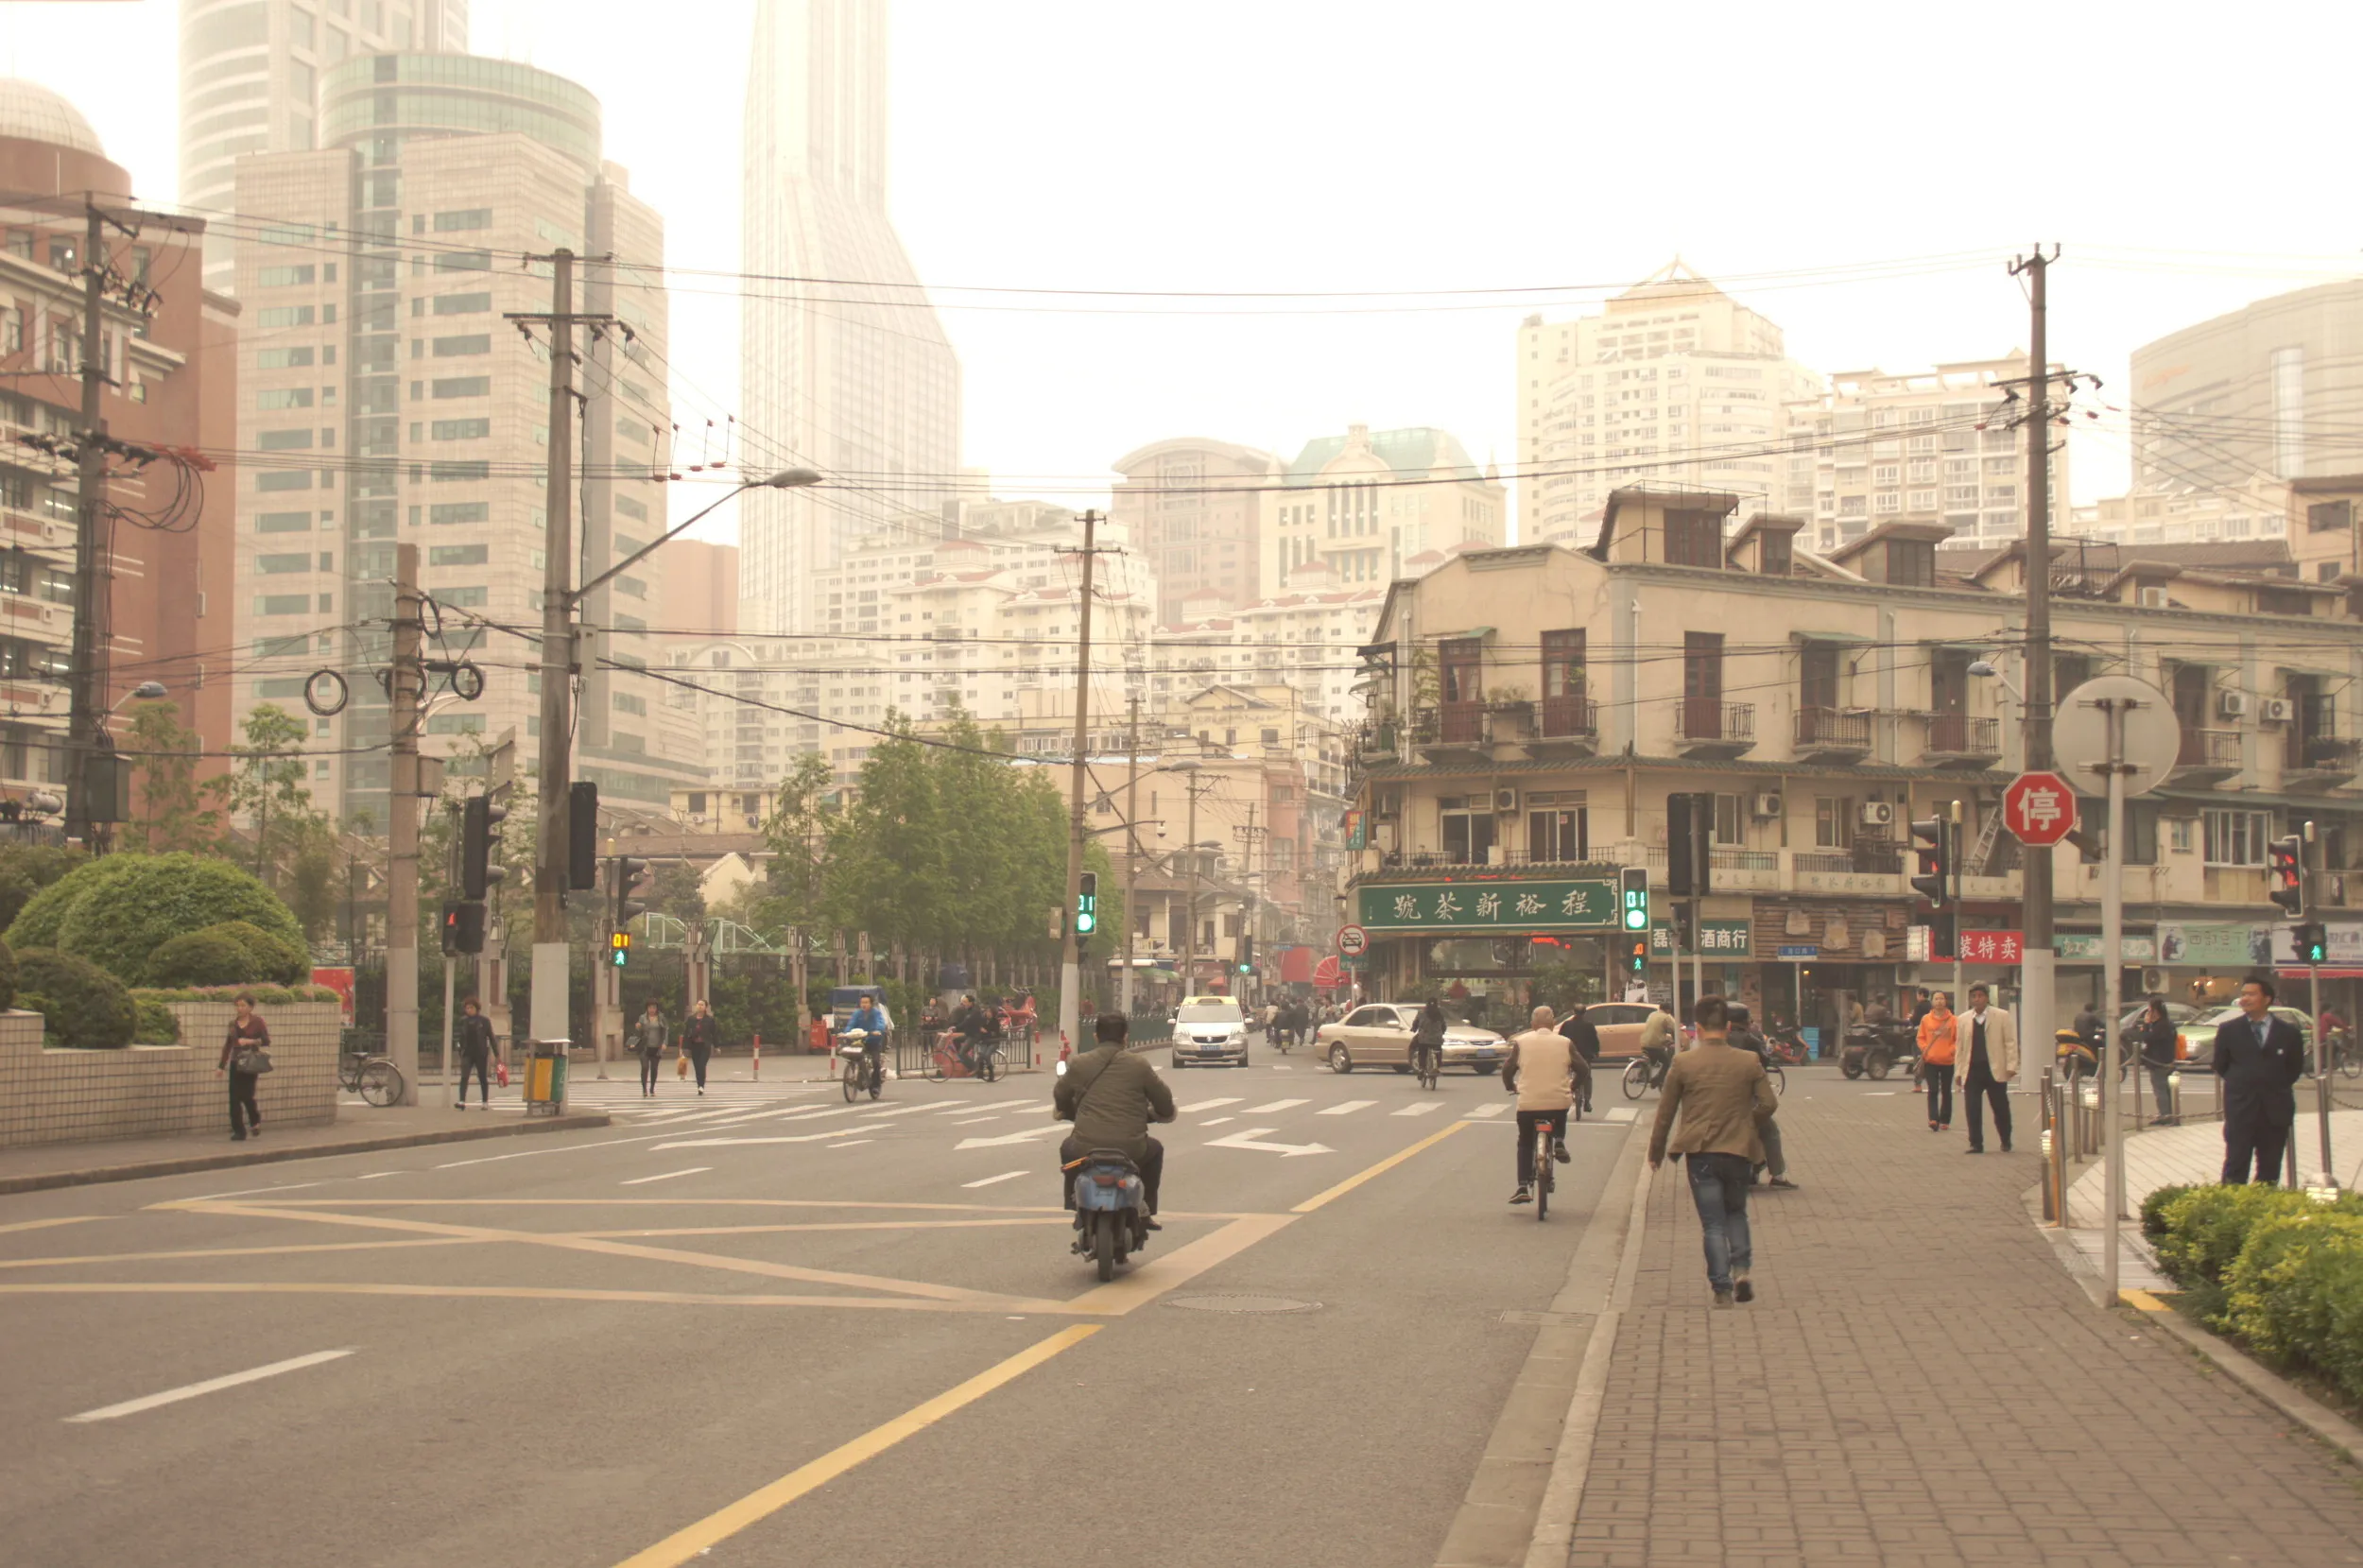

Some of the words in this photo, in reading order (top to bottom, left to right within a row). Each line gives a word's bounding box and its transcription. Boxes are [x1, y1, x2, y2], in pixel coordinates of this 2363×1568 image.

[2018, 786, 2061, 832] 停
[613, 933, 629, 947] 01
[1960, 935, 2018, 960] 装特卖
